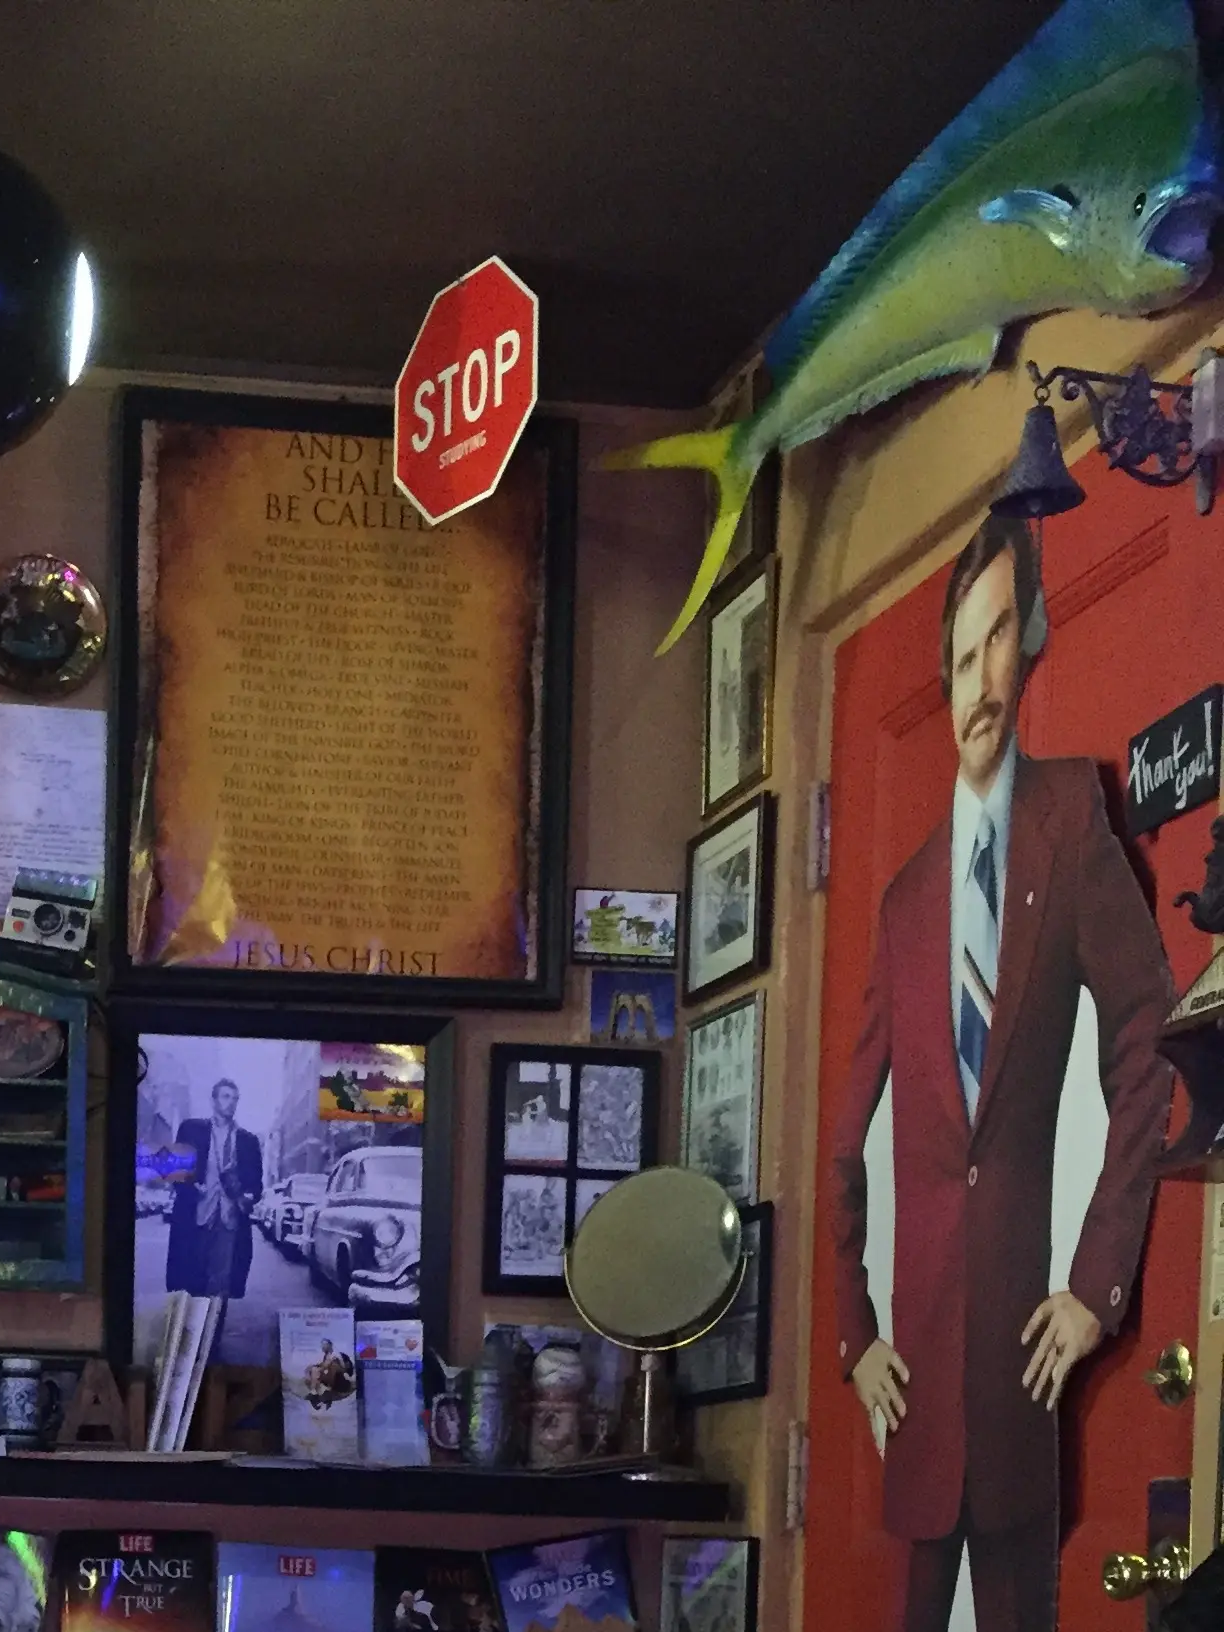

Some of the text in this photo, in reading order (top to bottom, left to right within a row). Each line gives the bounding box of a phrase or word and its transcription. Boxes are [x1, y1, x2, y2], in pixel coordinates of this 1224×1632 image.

[412, 329, 520, 453] STOP
[284, 434, 364, 464] AND
[265, 493, 302, 524] BE
[233, 939, 443, 976] JESUS CHRIST
[119, 1535, 153, 1552] LIFE
[78, 1557, 193, 1592] STRANGE
[279, 1557, 314, 1576] LIFE
[509, 1569, 616, 1602] WONDERS
[118, 1594, 165, 1618] TRUE
